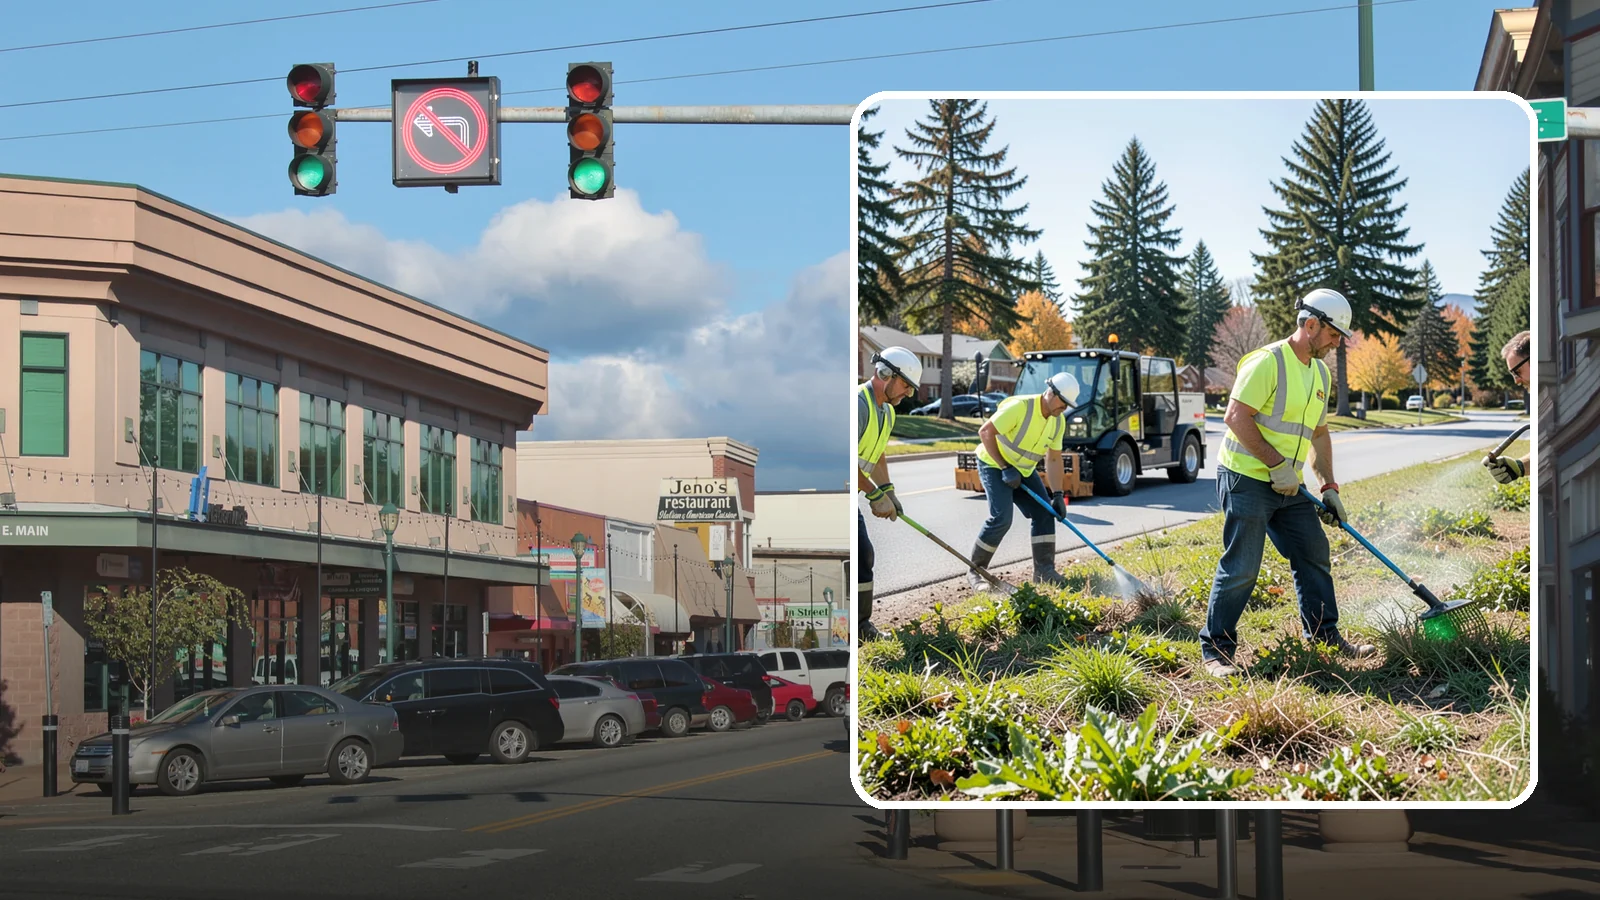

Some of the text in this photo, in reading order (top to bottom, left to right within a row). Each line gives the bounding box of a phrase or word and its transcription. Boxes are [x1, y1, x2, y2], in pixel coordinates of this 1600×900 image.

[670, 480, 727, 494] Jeno's
[665, 496, 731, 508] restaurant
[658, 510, 681, 519] Italian
[686, 510, 714, 519] American
[715, 510, 737, 519] Cuisine
[2, 525, 49, 536] E. MAIN
[797, 608, 829, 617] Street
[790, 619, 824, 627] lass
